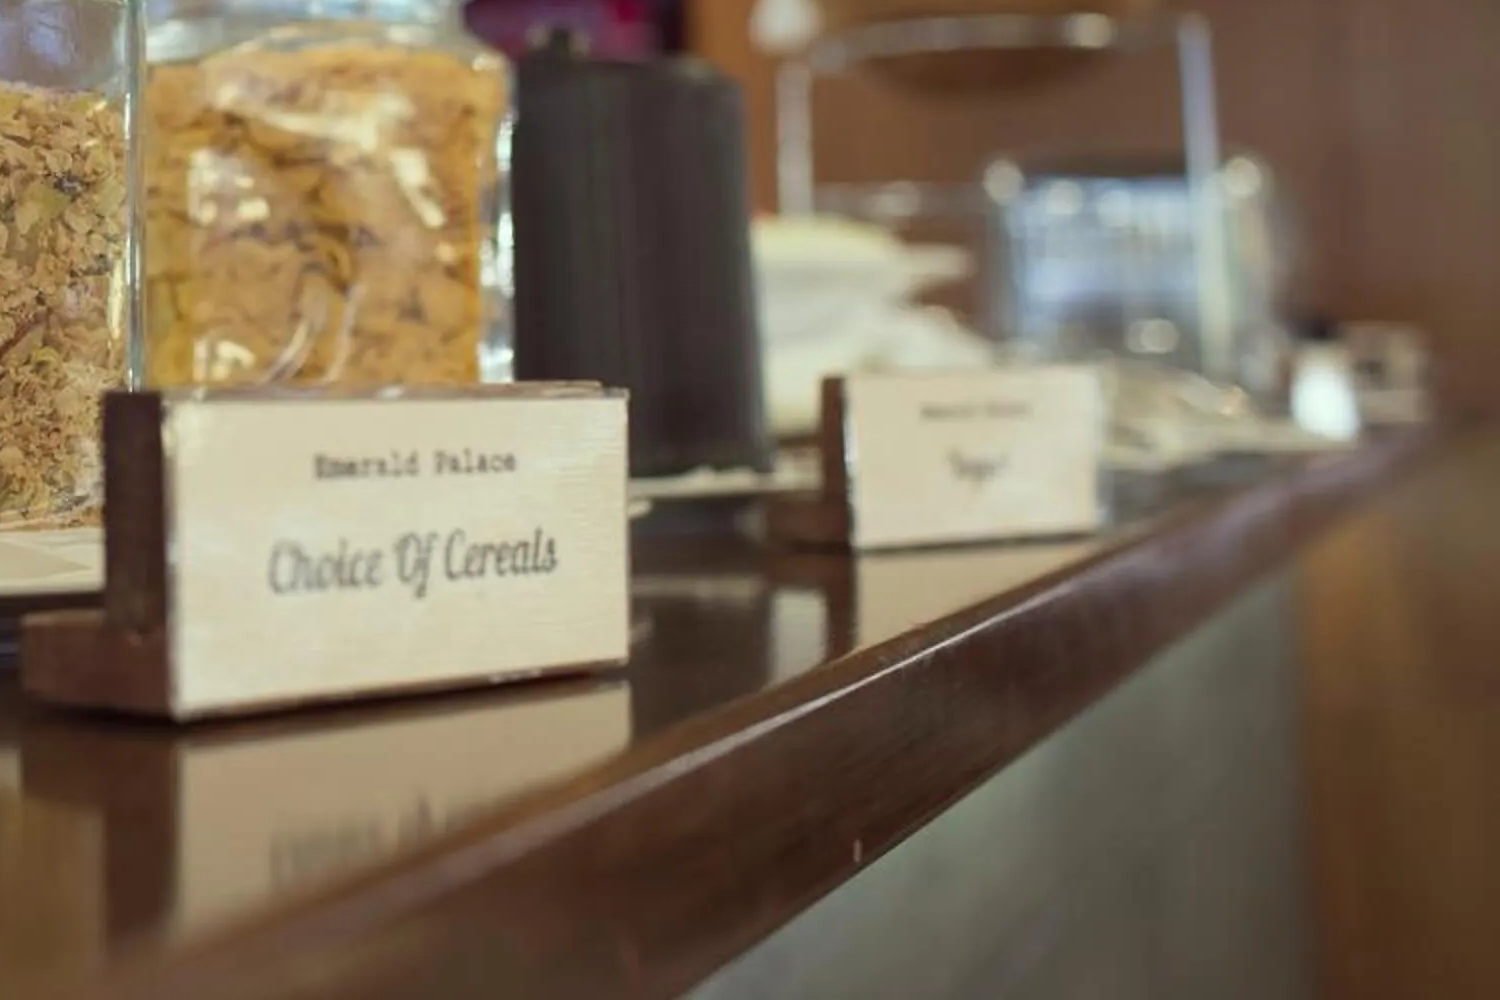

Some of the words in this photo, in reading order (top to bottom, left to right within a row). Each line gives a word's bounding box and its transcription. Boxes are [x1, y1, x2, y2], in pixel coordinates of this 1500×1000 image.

[314, 451, 419, 479] Emerald
[434, 448, 516, 475] Palace
[268, 538, 383, 594] Choice
[395, 531, 439, 600] Of
[444, 525, 558, 582] Cereals
